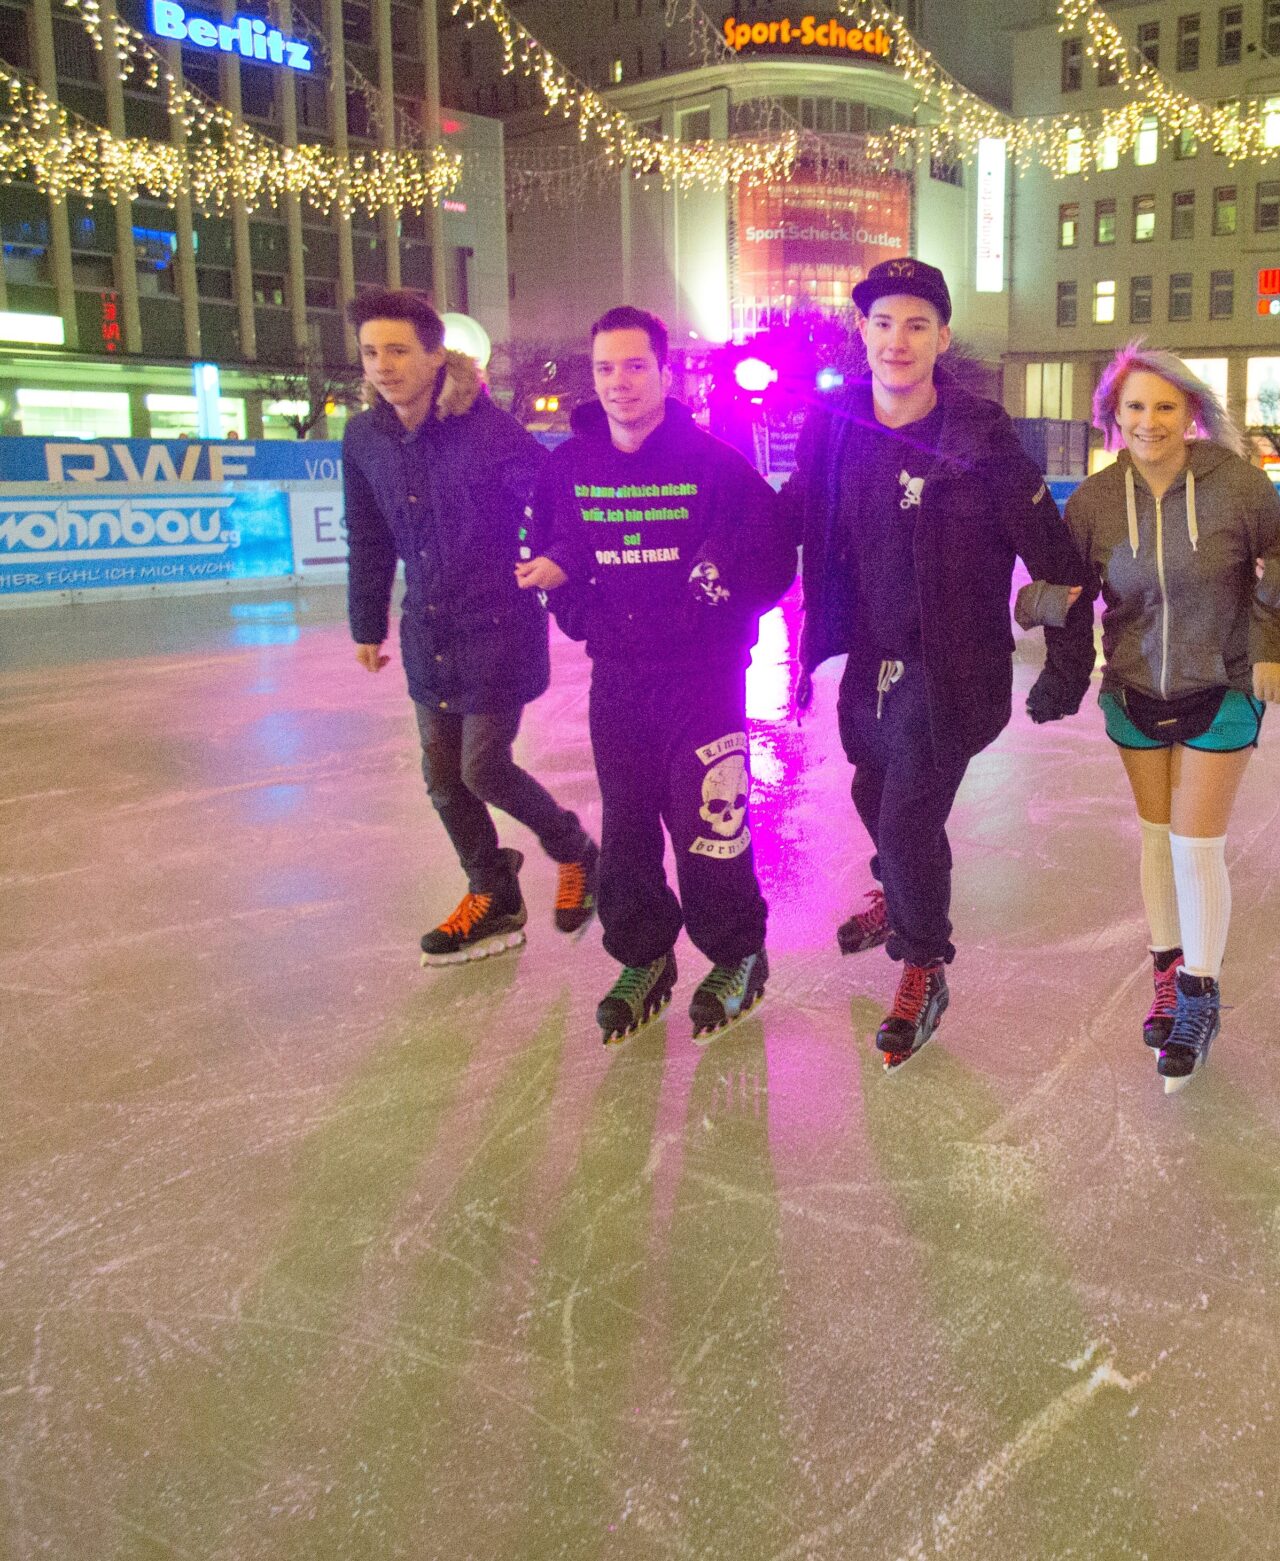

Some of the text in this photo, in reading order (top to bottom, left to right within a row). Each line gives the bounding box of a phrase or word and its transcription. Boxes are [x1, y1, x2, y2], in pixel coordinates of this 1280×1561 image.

[154, 0, 312, 71] Berlitz
[723, 15, 892, 54] Sport-Scheck
[856, 229, 902, 248] Outlet
[45, 443, 256, 482] RWE
[661, 483, 698, 496] nichts
[625, 508, 643, 522] bin
[644, 506, 689, 521] einfach
[623, 532, 641, 546] so!
[622, 550, 641, 564] ICE
[641, 547, 680, 563] FREAK
[105, 567, 137, 580] ICH
[141, 564, 184, 578] MICH
